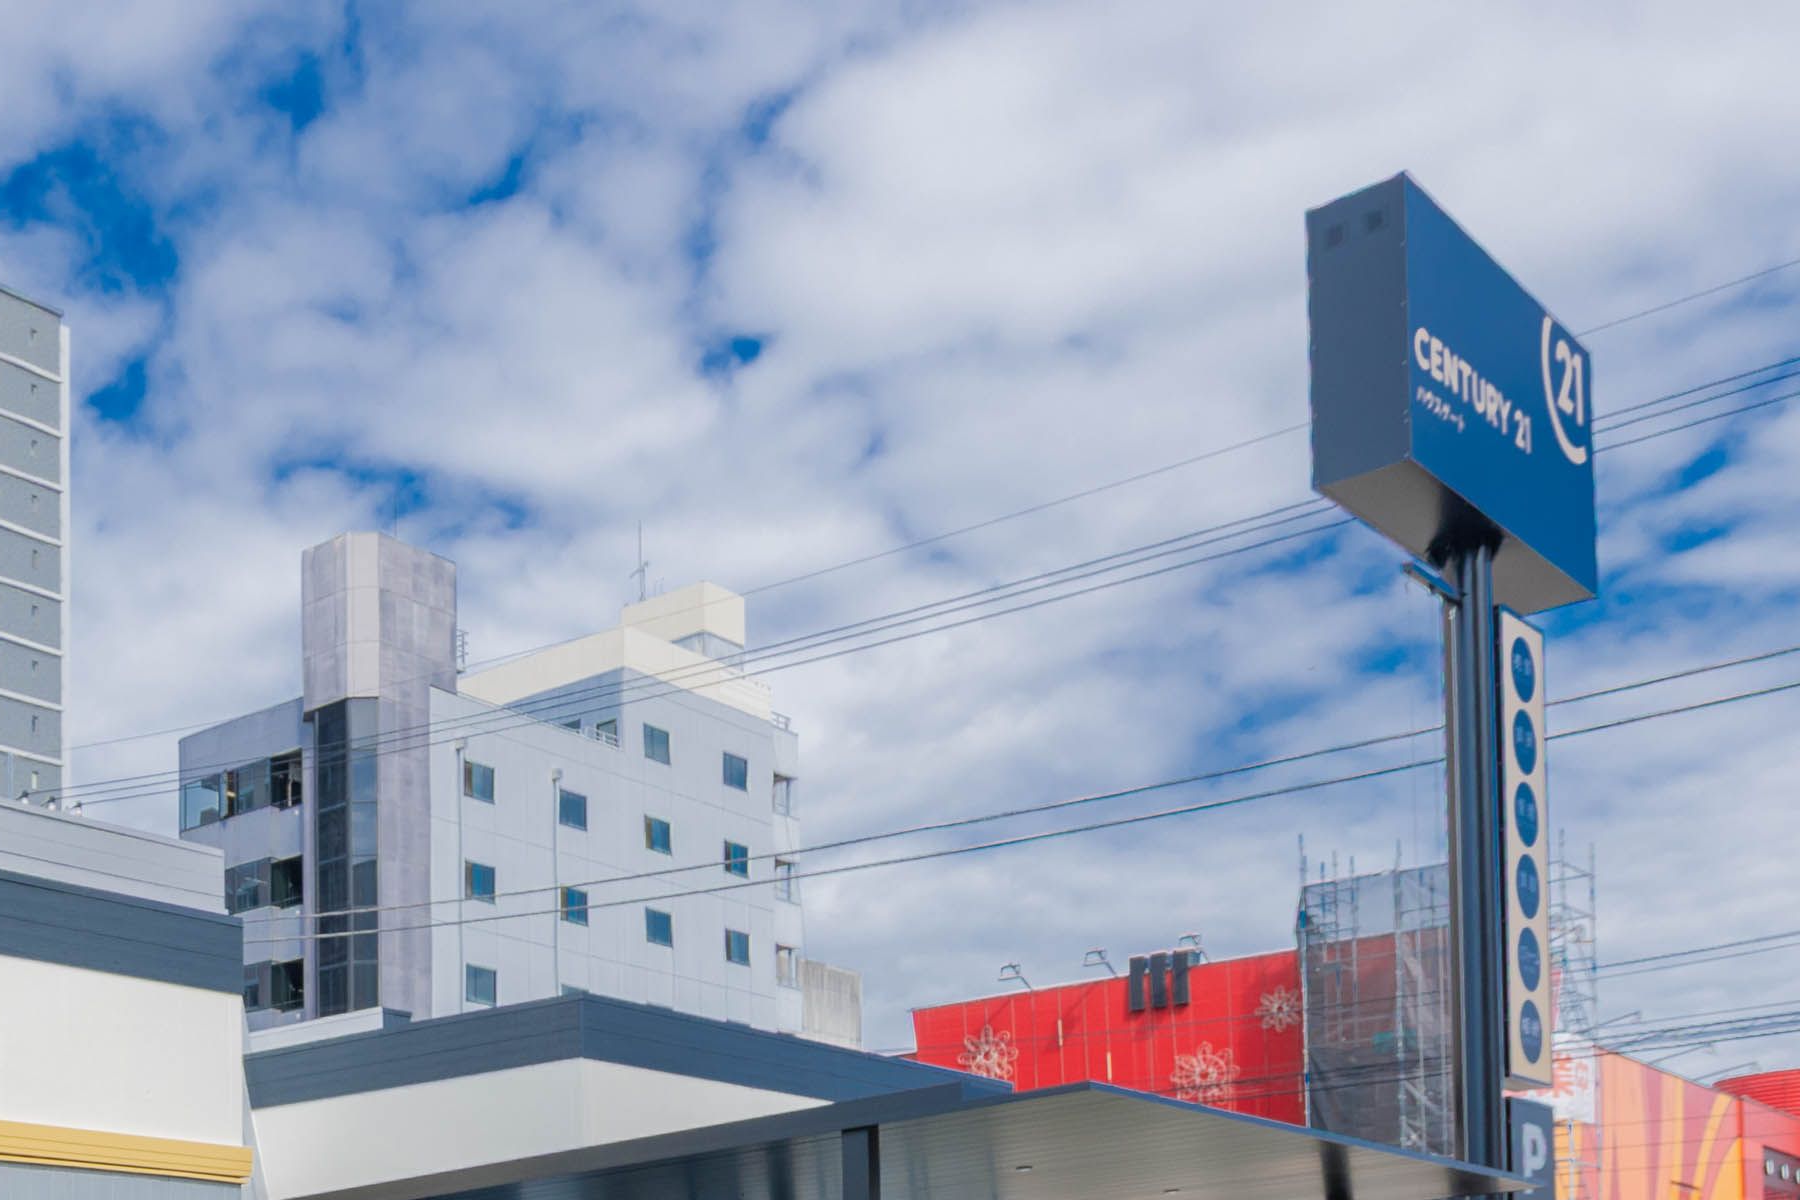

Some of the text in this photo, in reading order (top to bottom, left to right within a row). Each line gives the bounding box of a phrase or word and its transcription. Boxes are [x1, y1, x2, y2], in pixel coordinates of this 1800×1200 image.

[1414, 327, 1532, 454] CENTURY 21
[1521, 1121, 1548, 1195] P
